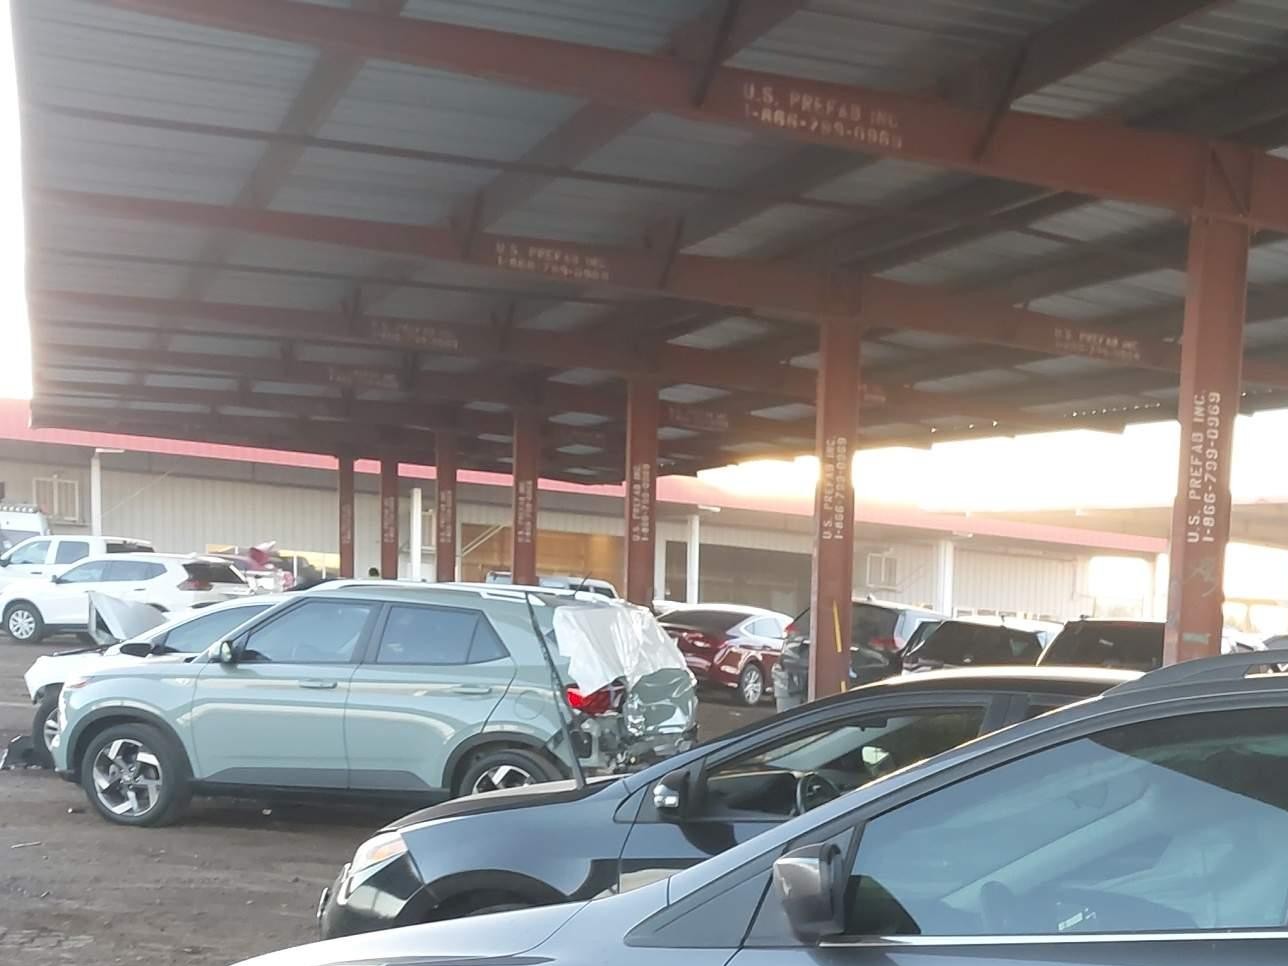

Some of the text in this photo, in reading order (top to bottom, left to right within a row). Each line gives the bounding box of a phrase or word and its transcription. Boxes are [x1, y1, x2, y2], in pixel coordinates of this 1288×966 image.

[1187, 390, 1207, 543] U.S. PREFAB INC.
[1202, 391, 1221, 543] 1-866-799-0969
